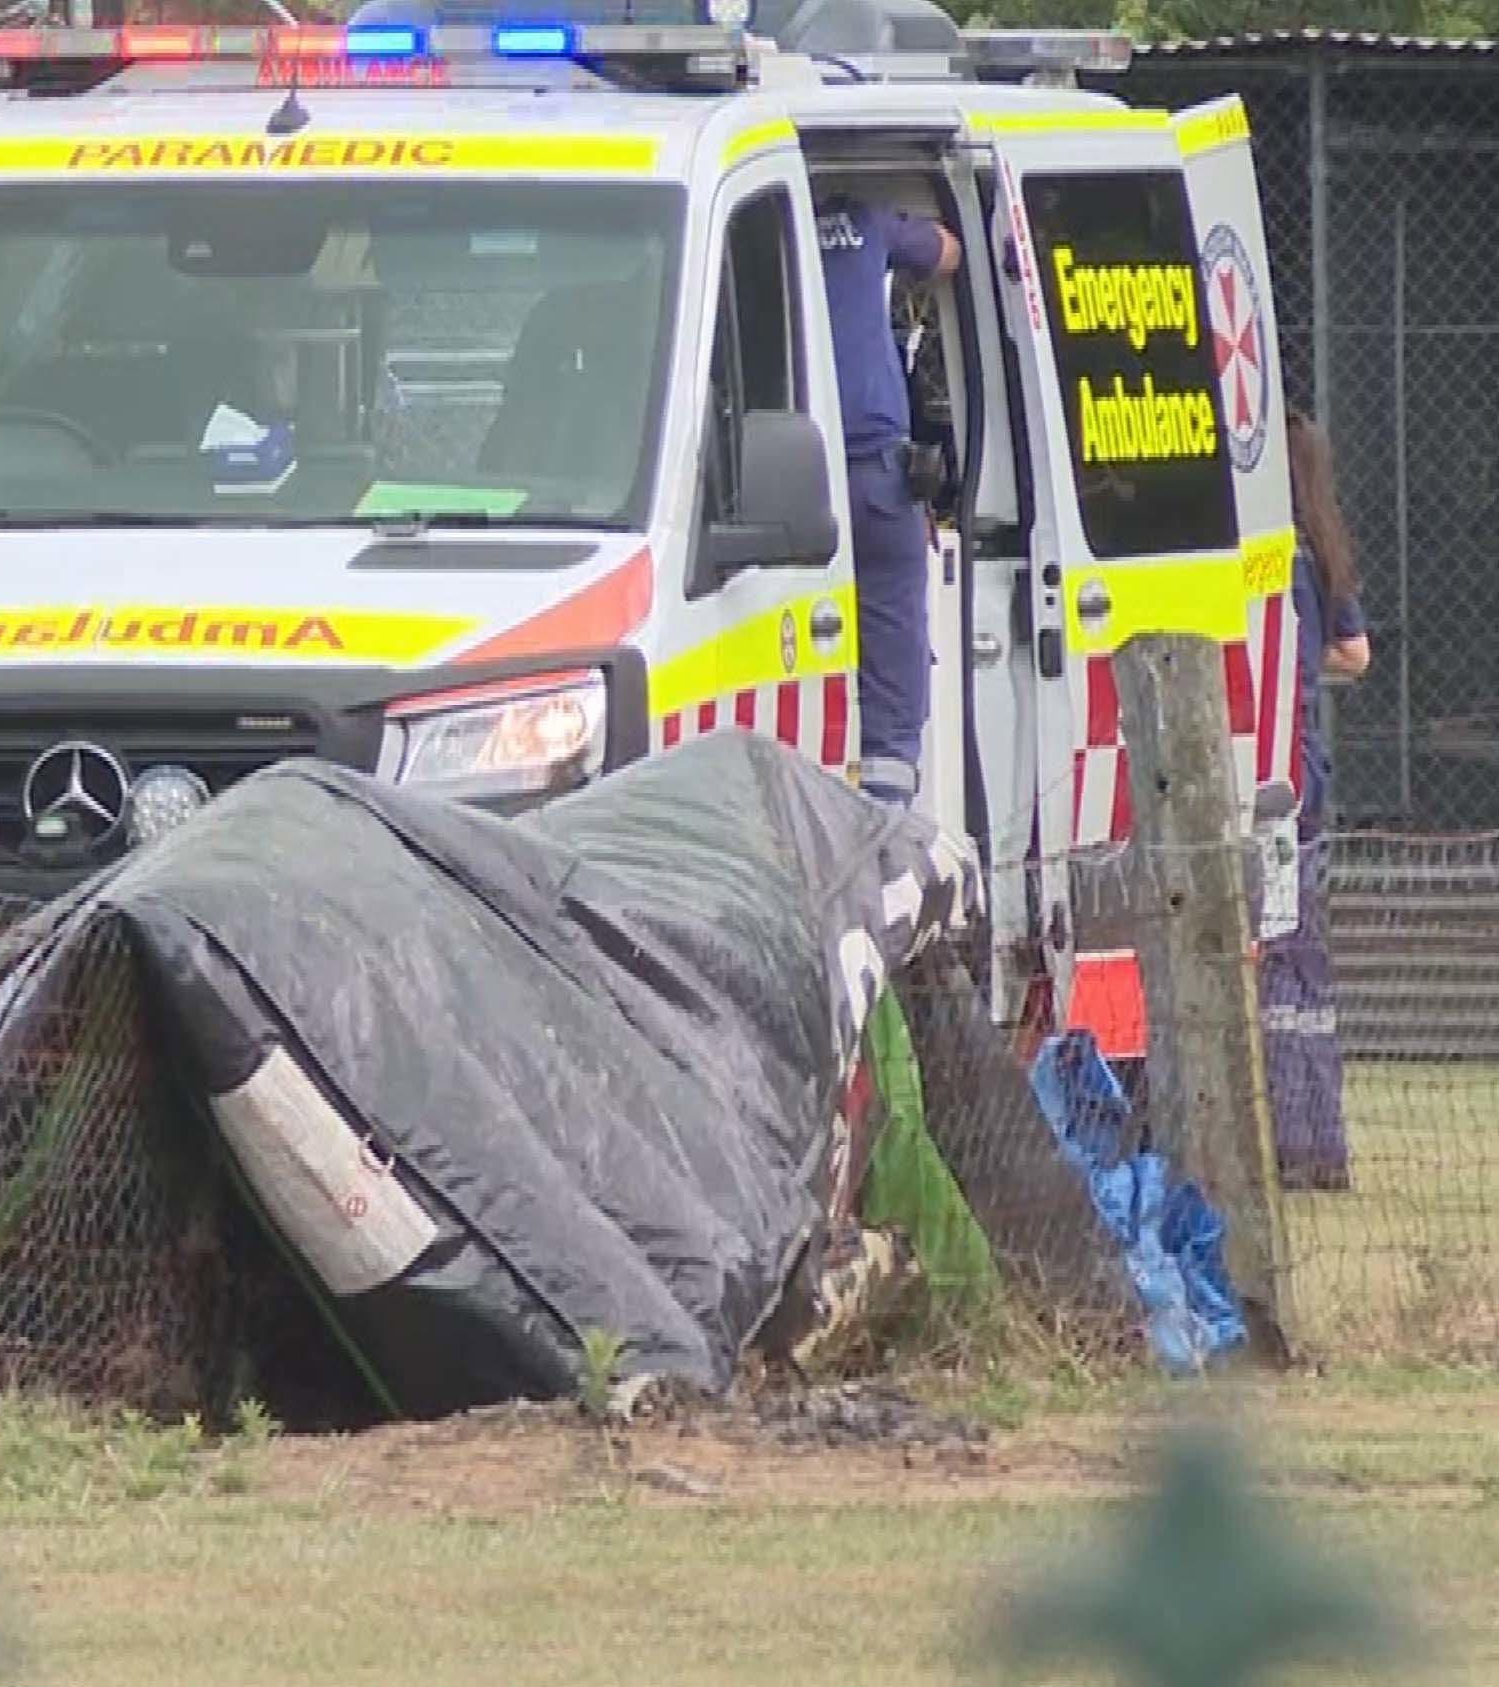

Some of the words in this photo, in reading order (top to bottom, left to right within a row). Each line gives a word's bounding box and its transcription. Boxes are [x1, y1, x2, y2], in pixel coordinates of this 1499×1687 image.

[67, 140, 454, 166] PARAMEDIC
[1052, 247, 1198, 350] Emergency
[1079, 373, 1216, 462] Ambulance
